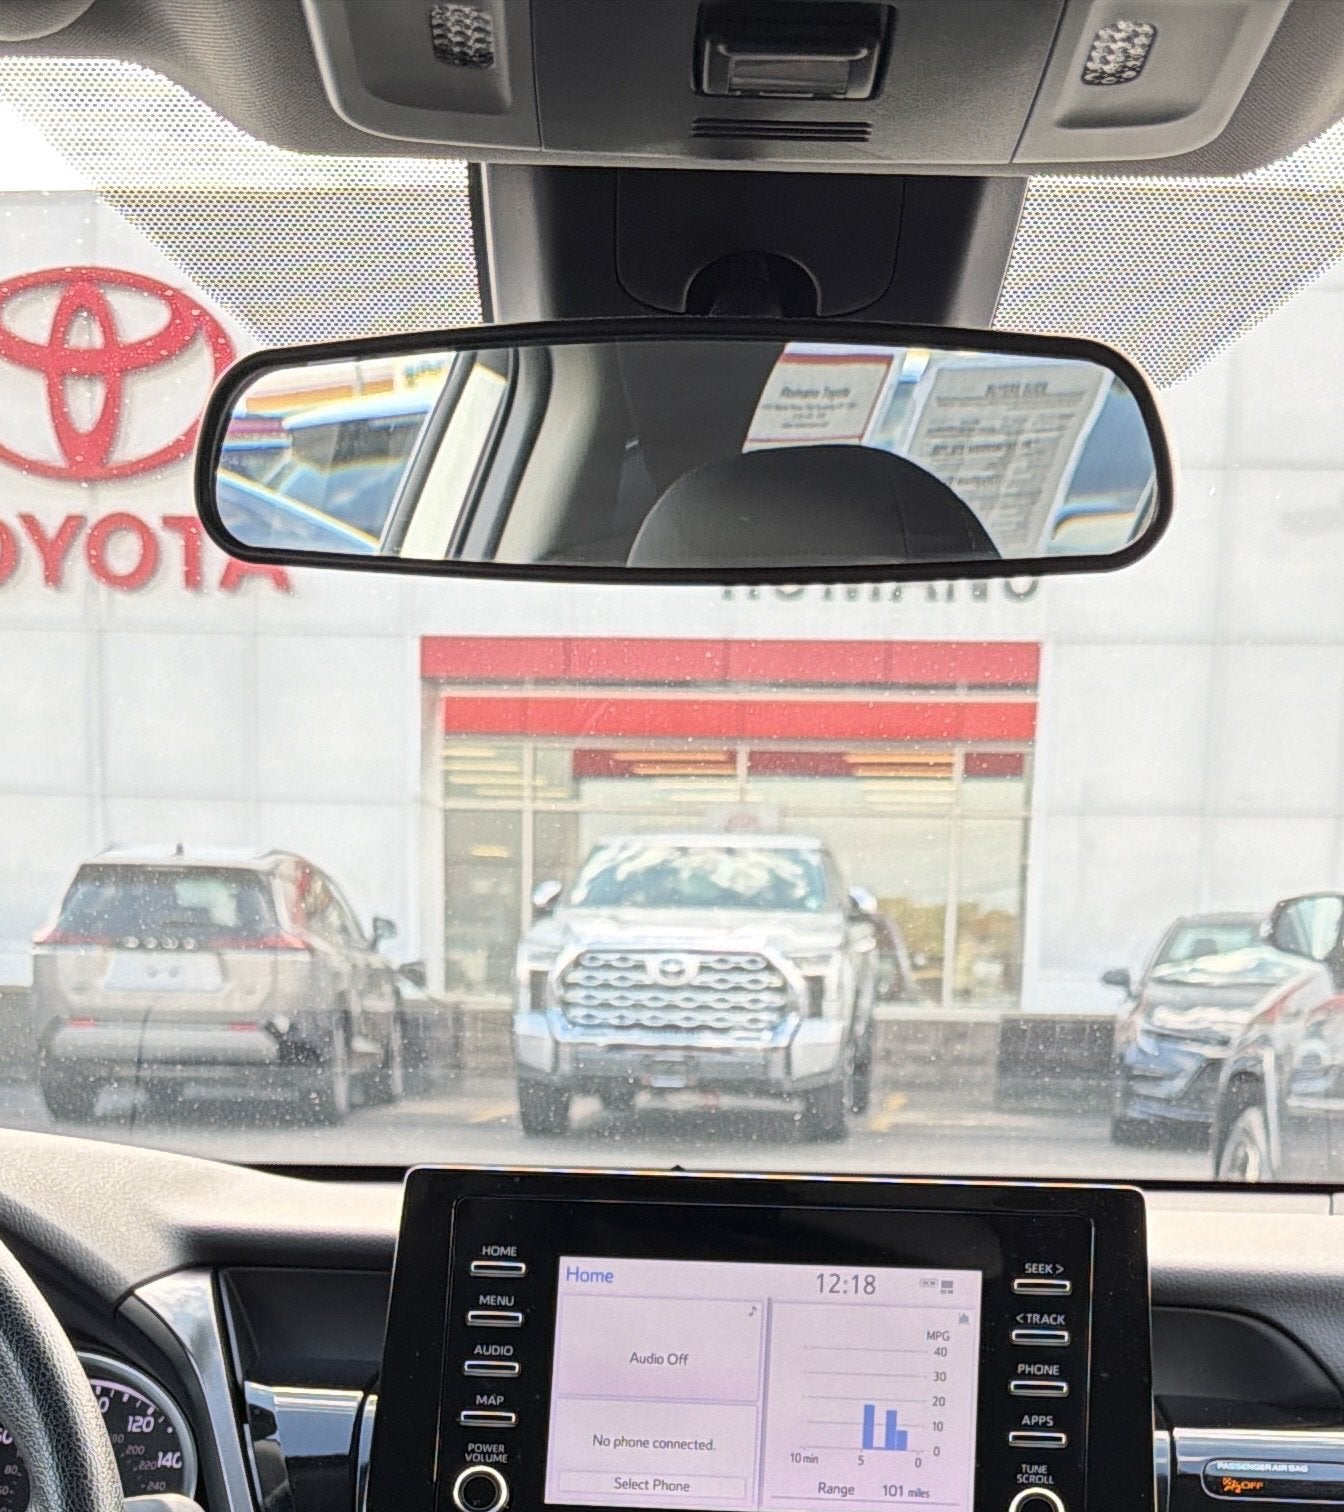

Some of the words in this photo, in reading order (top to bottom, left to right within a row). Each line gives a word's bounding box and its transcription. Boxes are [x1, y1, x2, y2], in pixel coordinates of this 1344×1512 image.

[482, 1245, 518, 1257] HOME
[566, 1266, 614, 1284] Home
[816, 1273, 876, 1296] 12:18
[479, 1295, 515, 1307] MENU
[926, 1330, 950, 1342] MPG
[474, 1344, 514, 1357] AUDIO
[933, 1346, 948, 1357] 40
[629, 1352, 664, 1366] Audio
[667, 1352, 689, 1366] Off
[1017, 1364, 1060, 1376] PHONE
[932, 1371, 947, 1383] 30
[476, 1394, 504, 1406] MAP
[932, 1396, 946, 1407] 20
[127, 1415, 155, 1433] 120
[932, 1421, 944, 1432] 10
[1021, 1415, 1054, 1427] APPS
[468, 1443, 505, 1454] POWER
[593, 1434, 611, 1449] No
[613, 1436, 649, 1452] phone
[652, 1436, 716, 1452] connected.
[933, 1447, 940, 1457] 0
[465, 1453, 508, 1464] VOLUME
[790, 1453, 801, 1463] 10
[802, 1454, 819, 1465] min
[857, 1456, 864, 1466] 5
[914, 1458, 922, 1468] 0
[1021, 1464, 1048, 1474] TUNE
[614, 1477, 649, 1491] Select
[653, 1478, 690, 1493] Phone
[1016, 1474, 1054, 1484] SCROLL
[1242, 1481, 1264, 1489] OFF
[818, 1482, 855, 1497] Range
[883, 1485, 904, 1497] 101
[908, 1487, 930, 1498] miles
